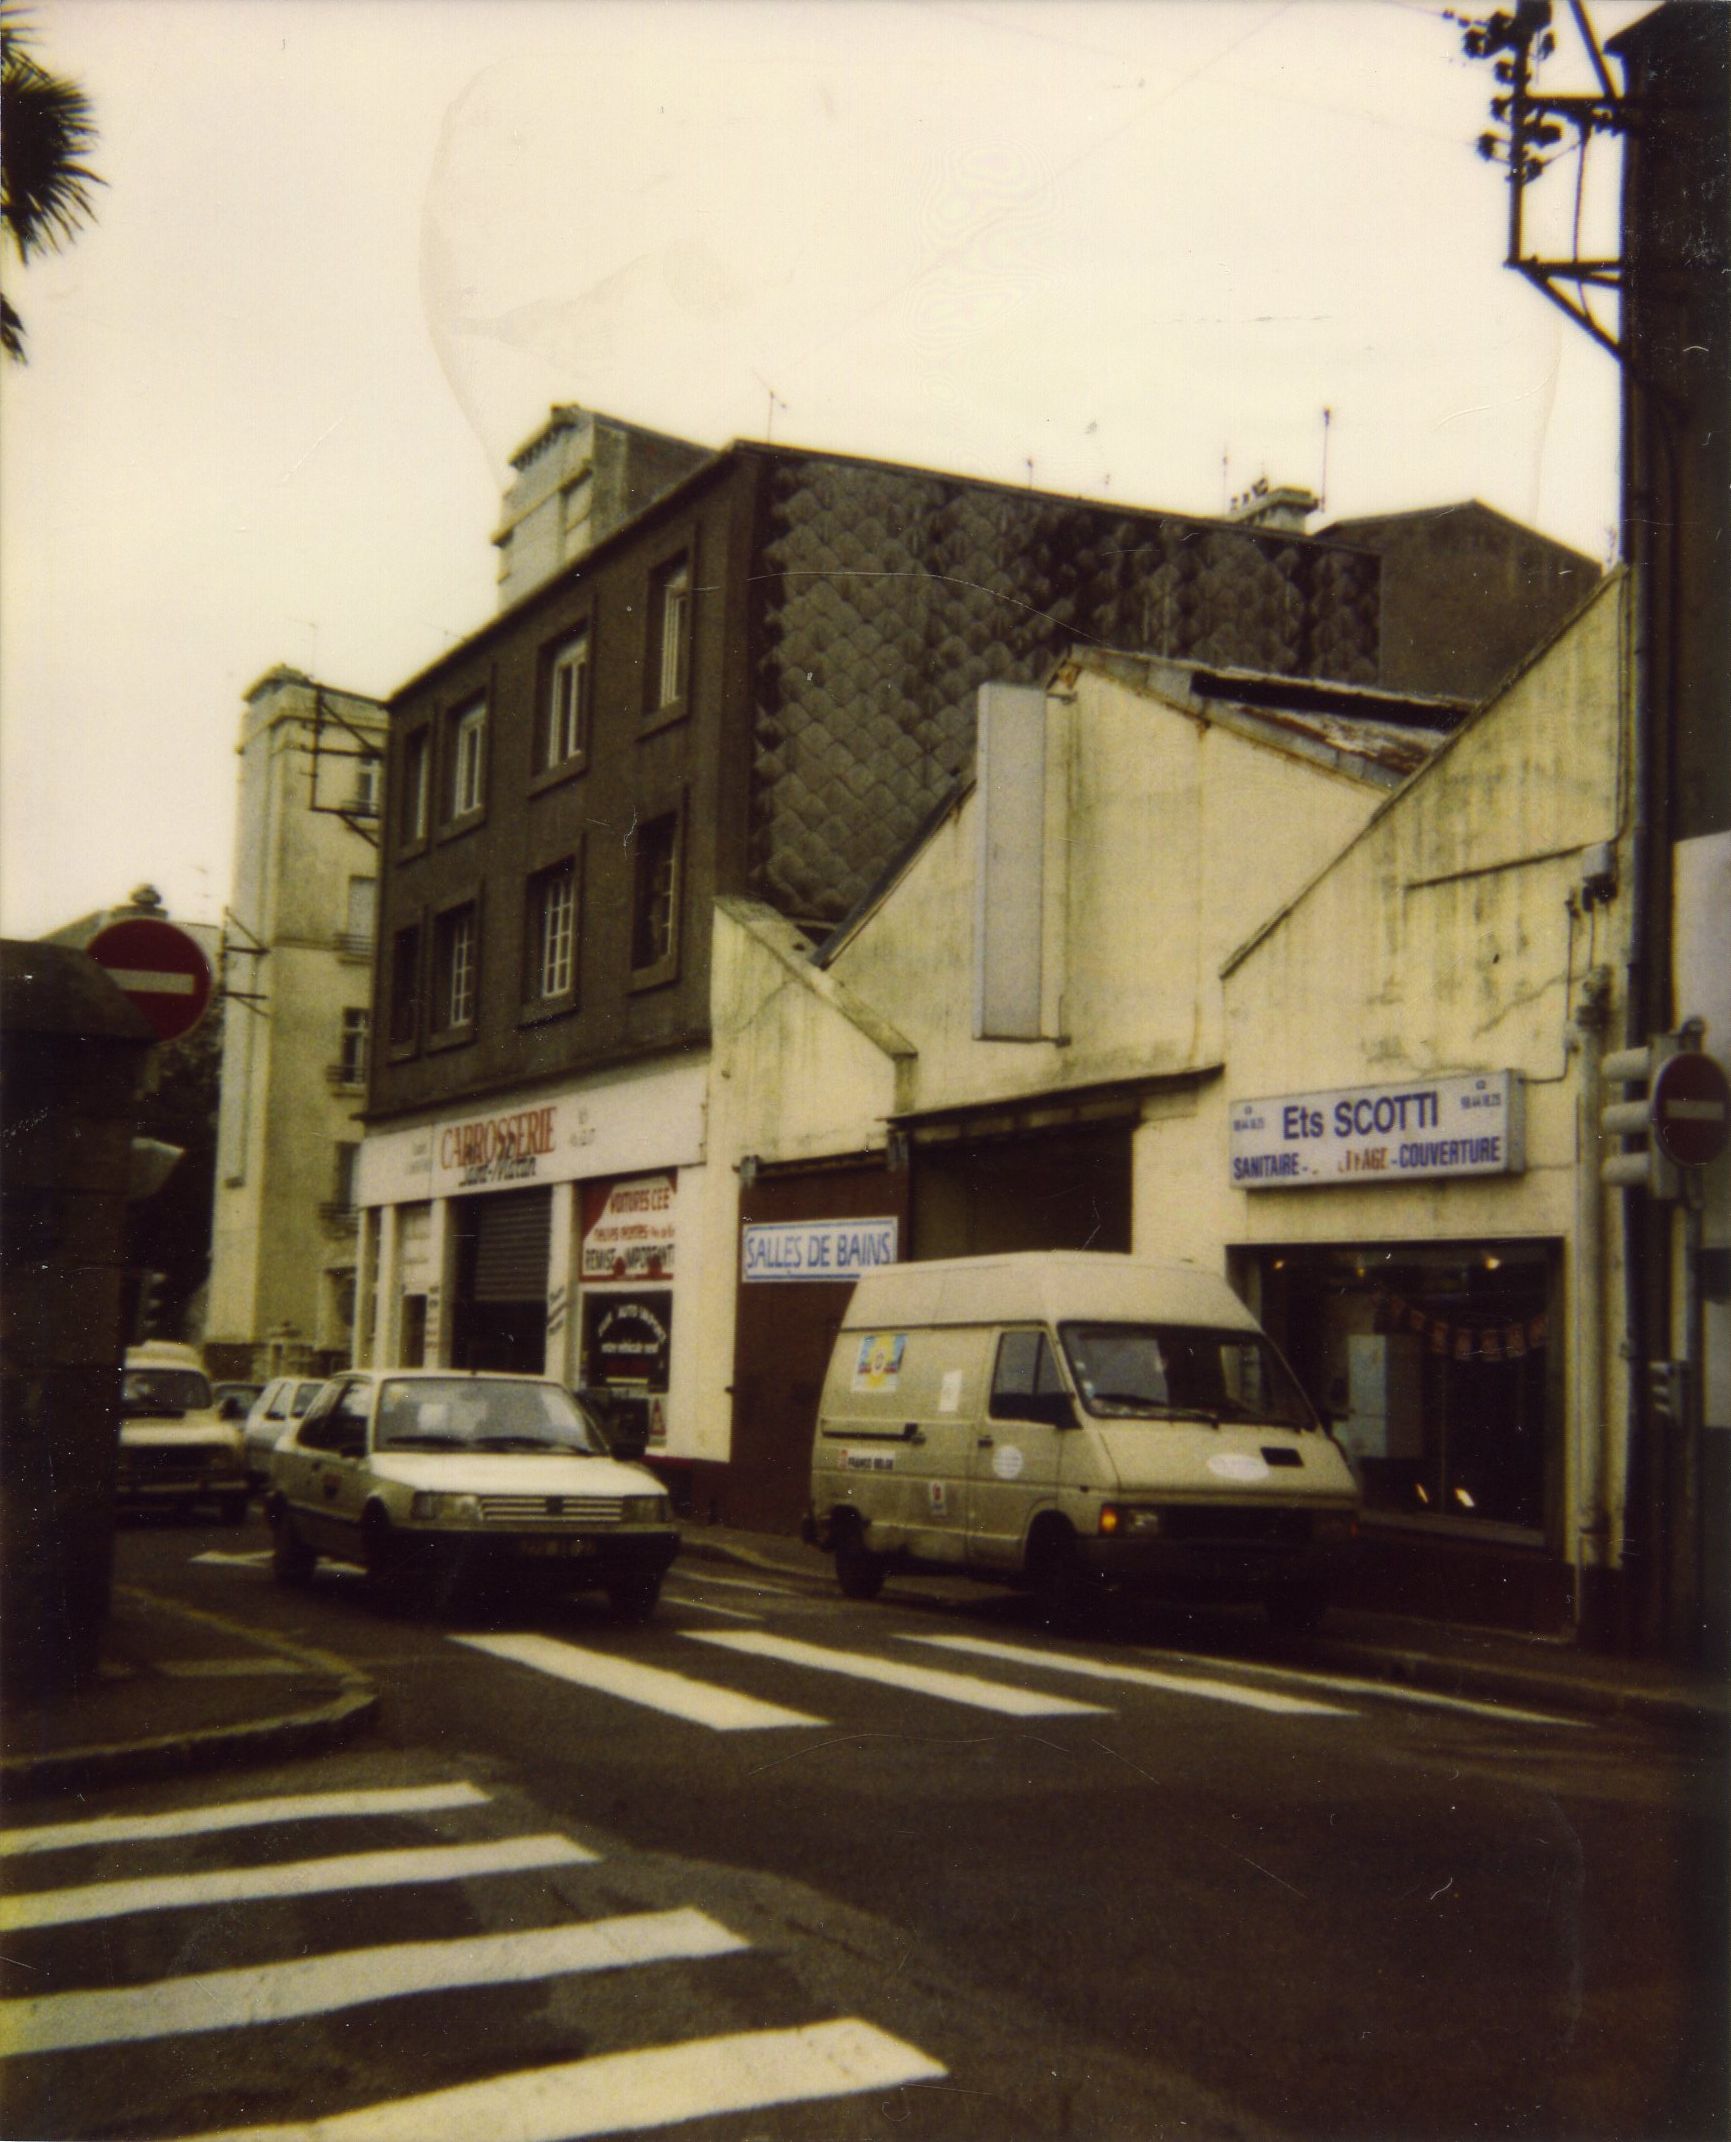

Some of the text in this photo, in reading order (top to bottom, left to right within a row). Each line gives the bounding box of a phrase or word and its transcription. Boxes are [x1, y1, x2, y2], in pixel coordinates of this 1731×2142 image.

[441, 1106, 557, 1170] CARROSSERIE
[1283, 1091, 1438, 1140] Ets SCOTTI
[1233, 1152, 1299, 1180] SANITAIRE
[1400, 1137, 1500, 1169] COUVERTURE
[747, 1232, 890, 1268] SALLES DE BAINS
